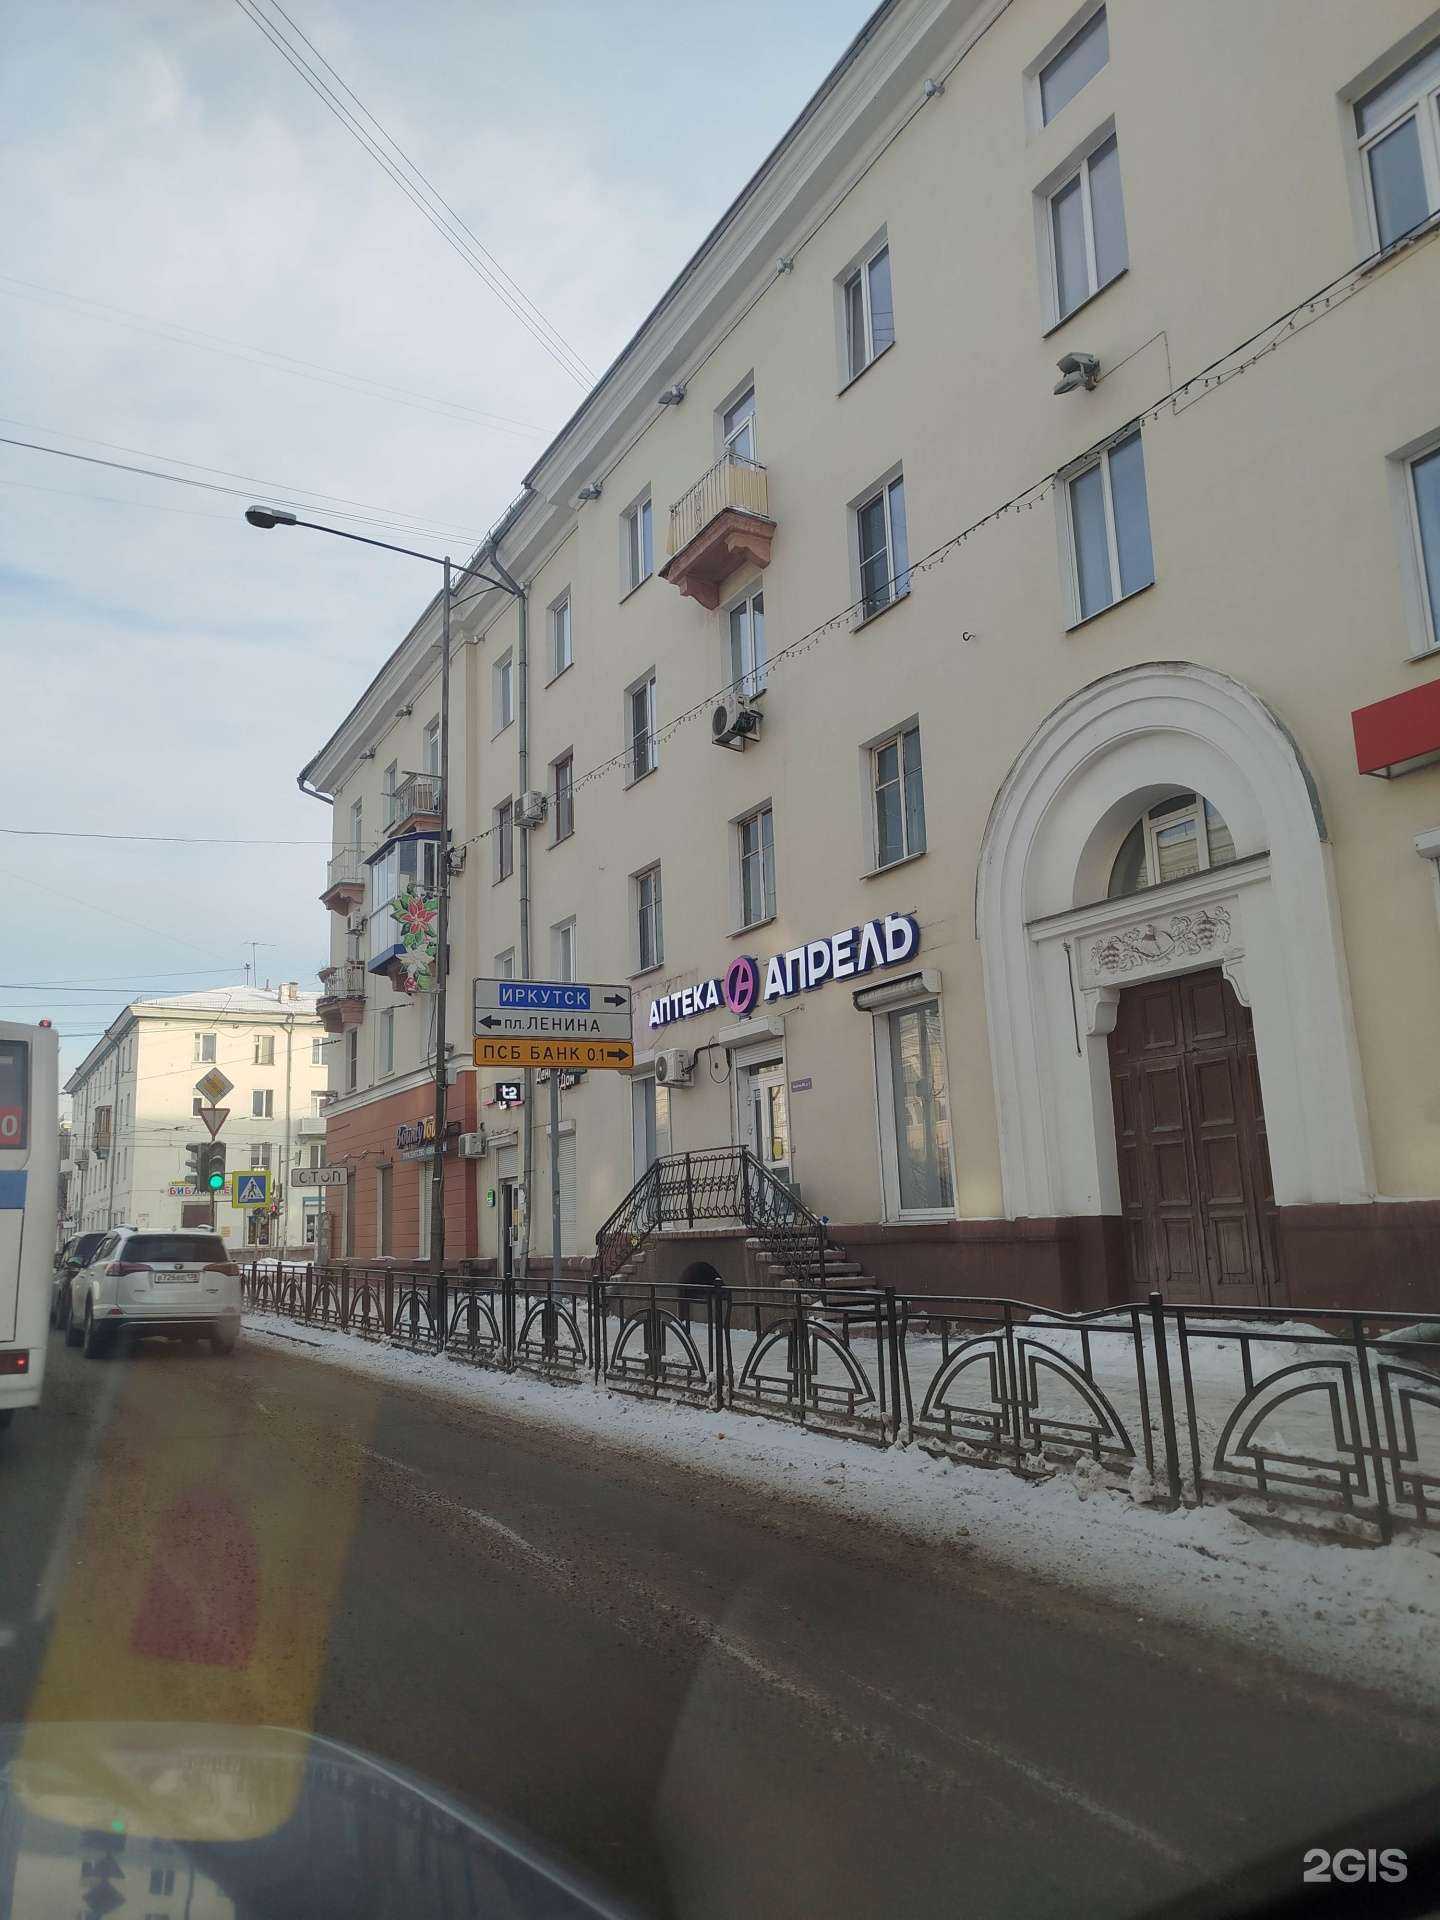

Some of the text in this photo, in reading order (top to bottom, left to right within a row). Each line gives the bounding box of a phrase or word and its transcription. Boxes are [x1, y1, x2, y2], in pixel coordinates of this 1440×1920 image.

[763, 914, 915, 1001] АПРЕЛЬ
[502, 987, 588, 1006] ИРКУТСК
[648, 978, 720, 1028] АПТЕКА
[483, 1044, 521, 1060] ПСБ
[530, 1046, 580, 1061] БАНК
